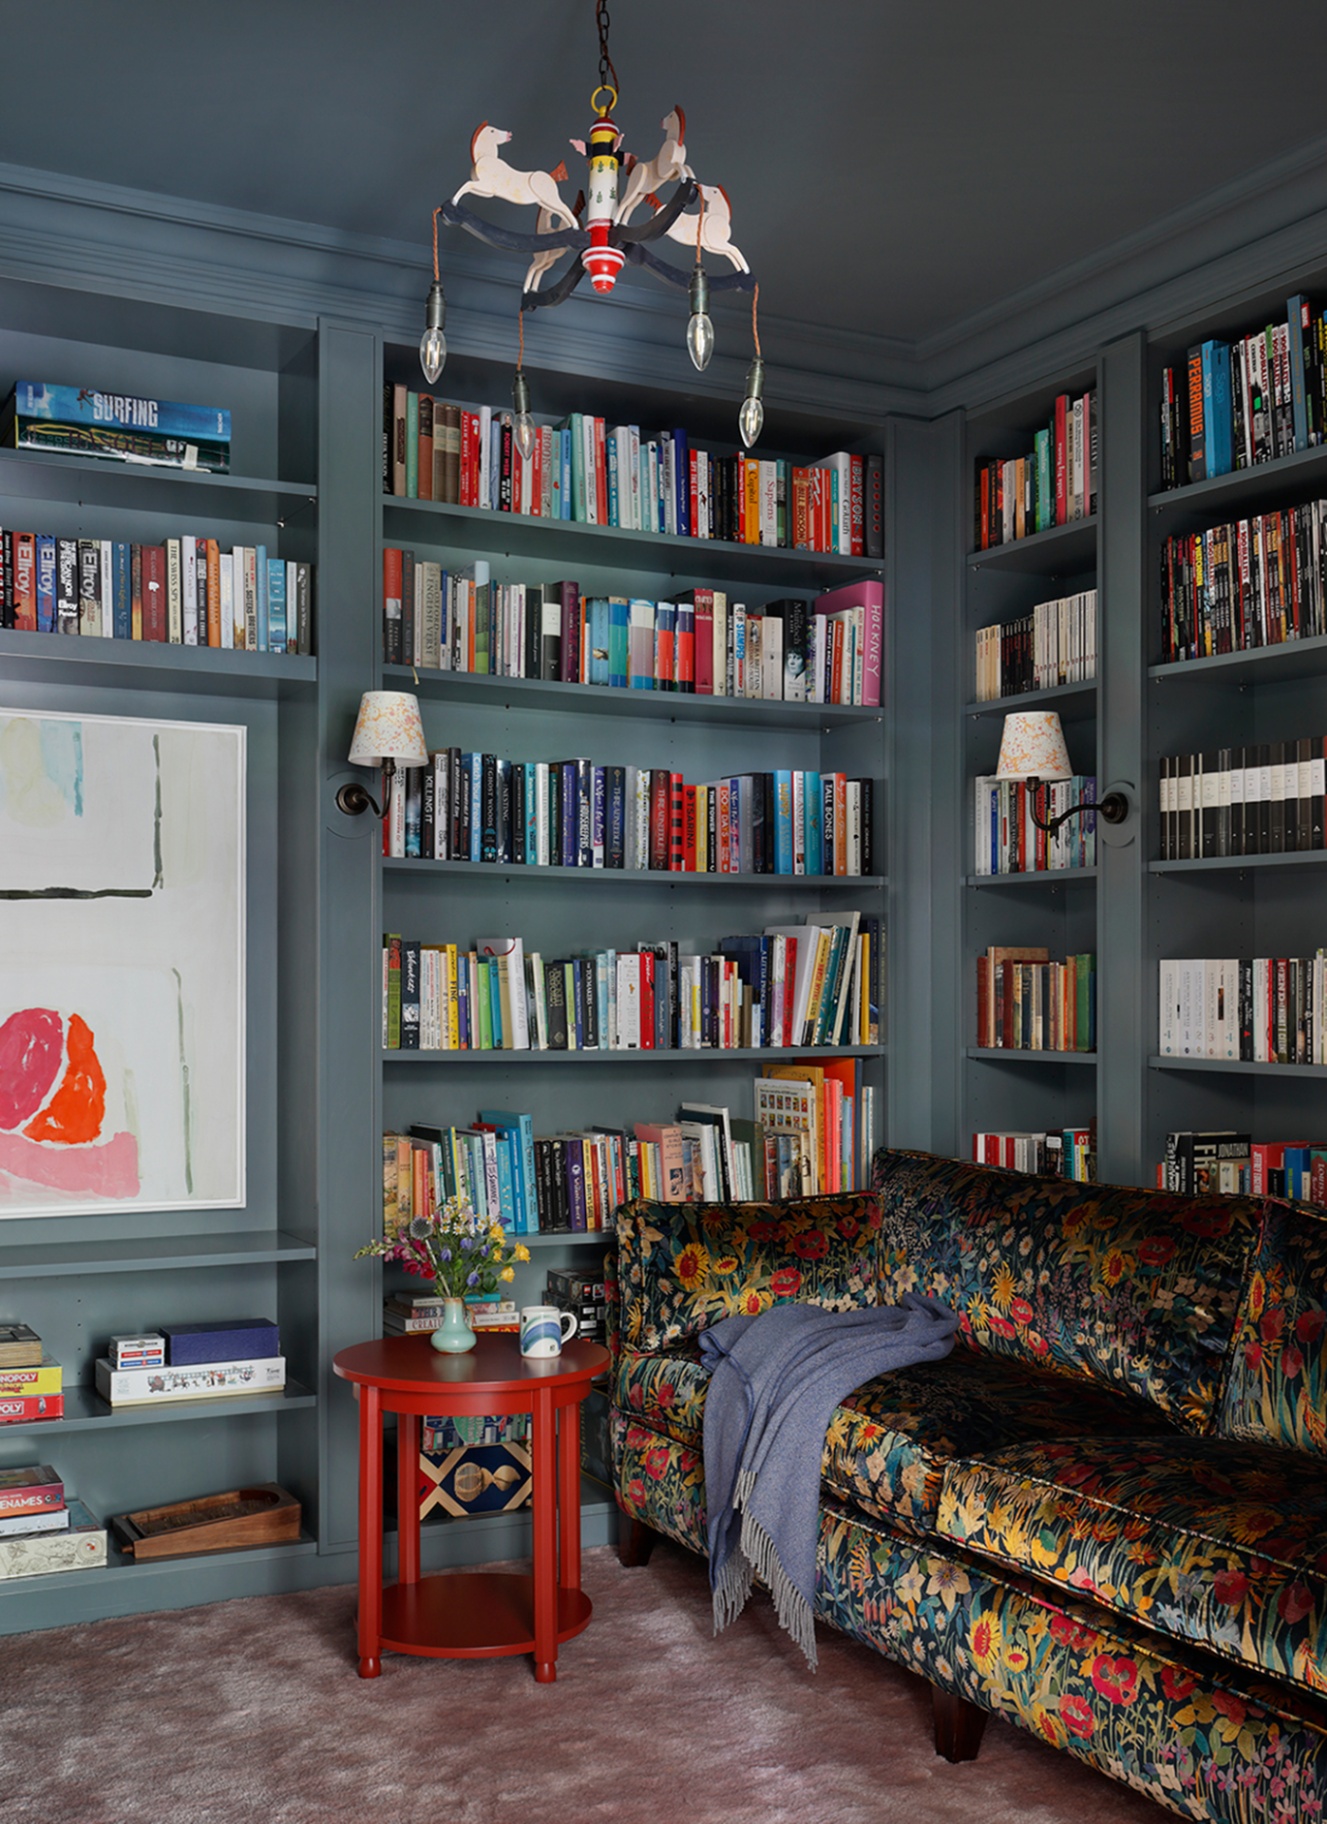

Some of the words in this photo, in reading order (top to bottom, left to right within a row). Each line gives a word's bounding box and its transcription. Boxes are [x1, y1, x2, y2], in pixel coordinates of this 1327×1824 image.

[92, 393, 158, 428] SURFING
[1188, 358, 1204, 435] PERRAMUS
[504, 432, 512, 456] ROBERT
[746, 471, 758, 504] Capital
[764, 480, 776, 520] Sapiens
[796, 486, 807, 506] BILL
[852, 466, 863, 525] BRYSON
[796, 506, 807, 540] BRYSON
[842, 500, 850, 534] Goliath
[15, 546, 33, 594] Ellroy
[38, 548, 56, 595] Ellroy
[80, 552, 98, 599] Ellroy
[794, 602, 802, 645] Murdoch
[736, 624, 746, 659] STAMPED
[866, 605, 880, 678] HOCKNEY
[474, 756, 482, 780] Catch
[425, 776, 434, 812] KILLING
[473, 782, 481, 802] Your
[720, 790, 730, 812] DOG
[825, 784, 833, 804] TALL
[425, 814, 433, 824] IT
[686, 802, 695, 848] TSARINA
[720, 814, 729, 837] DAYS
[825, 806, 833, 841] BONES
[406, 950, 417, 994] Blankets
